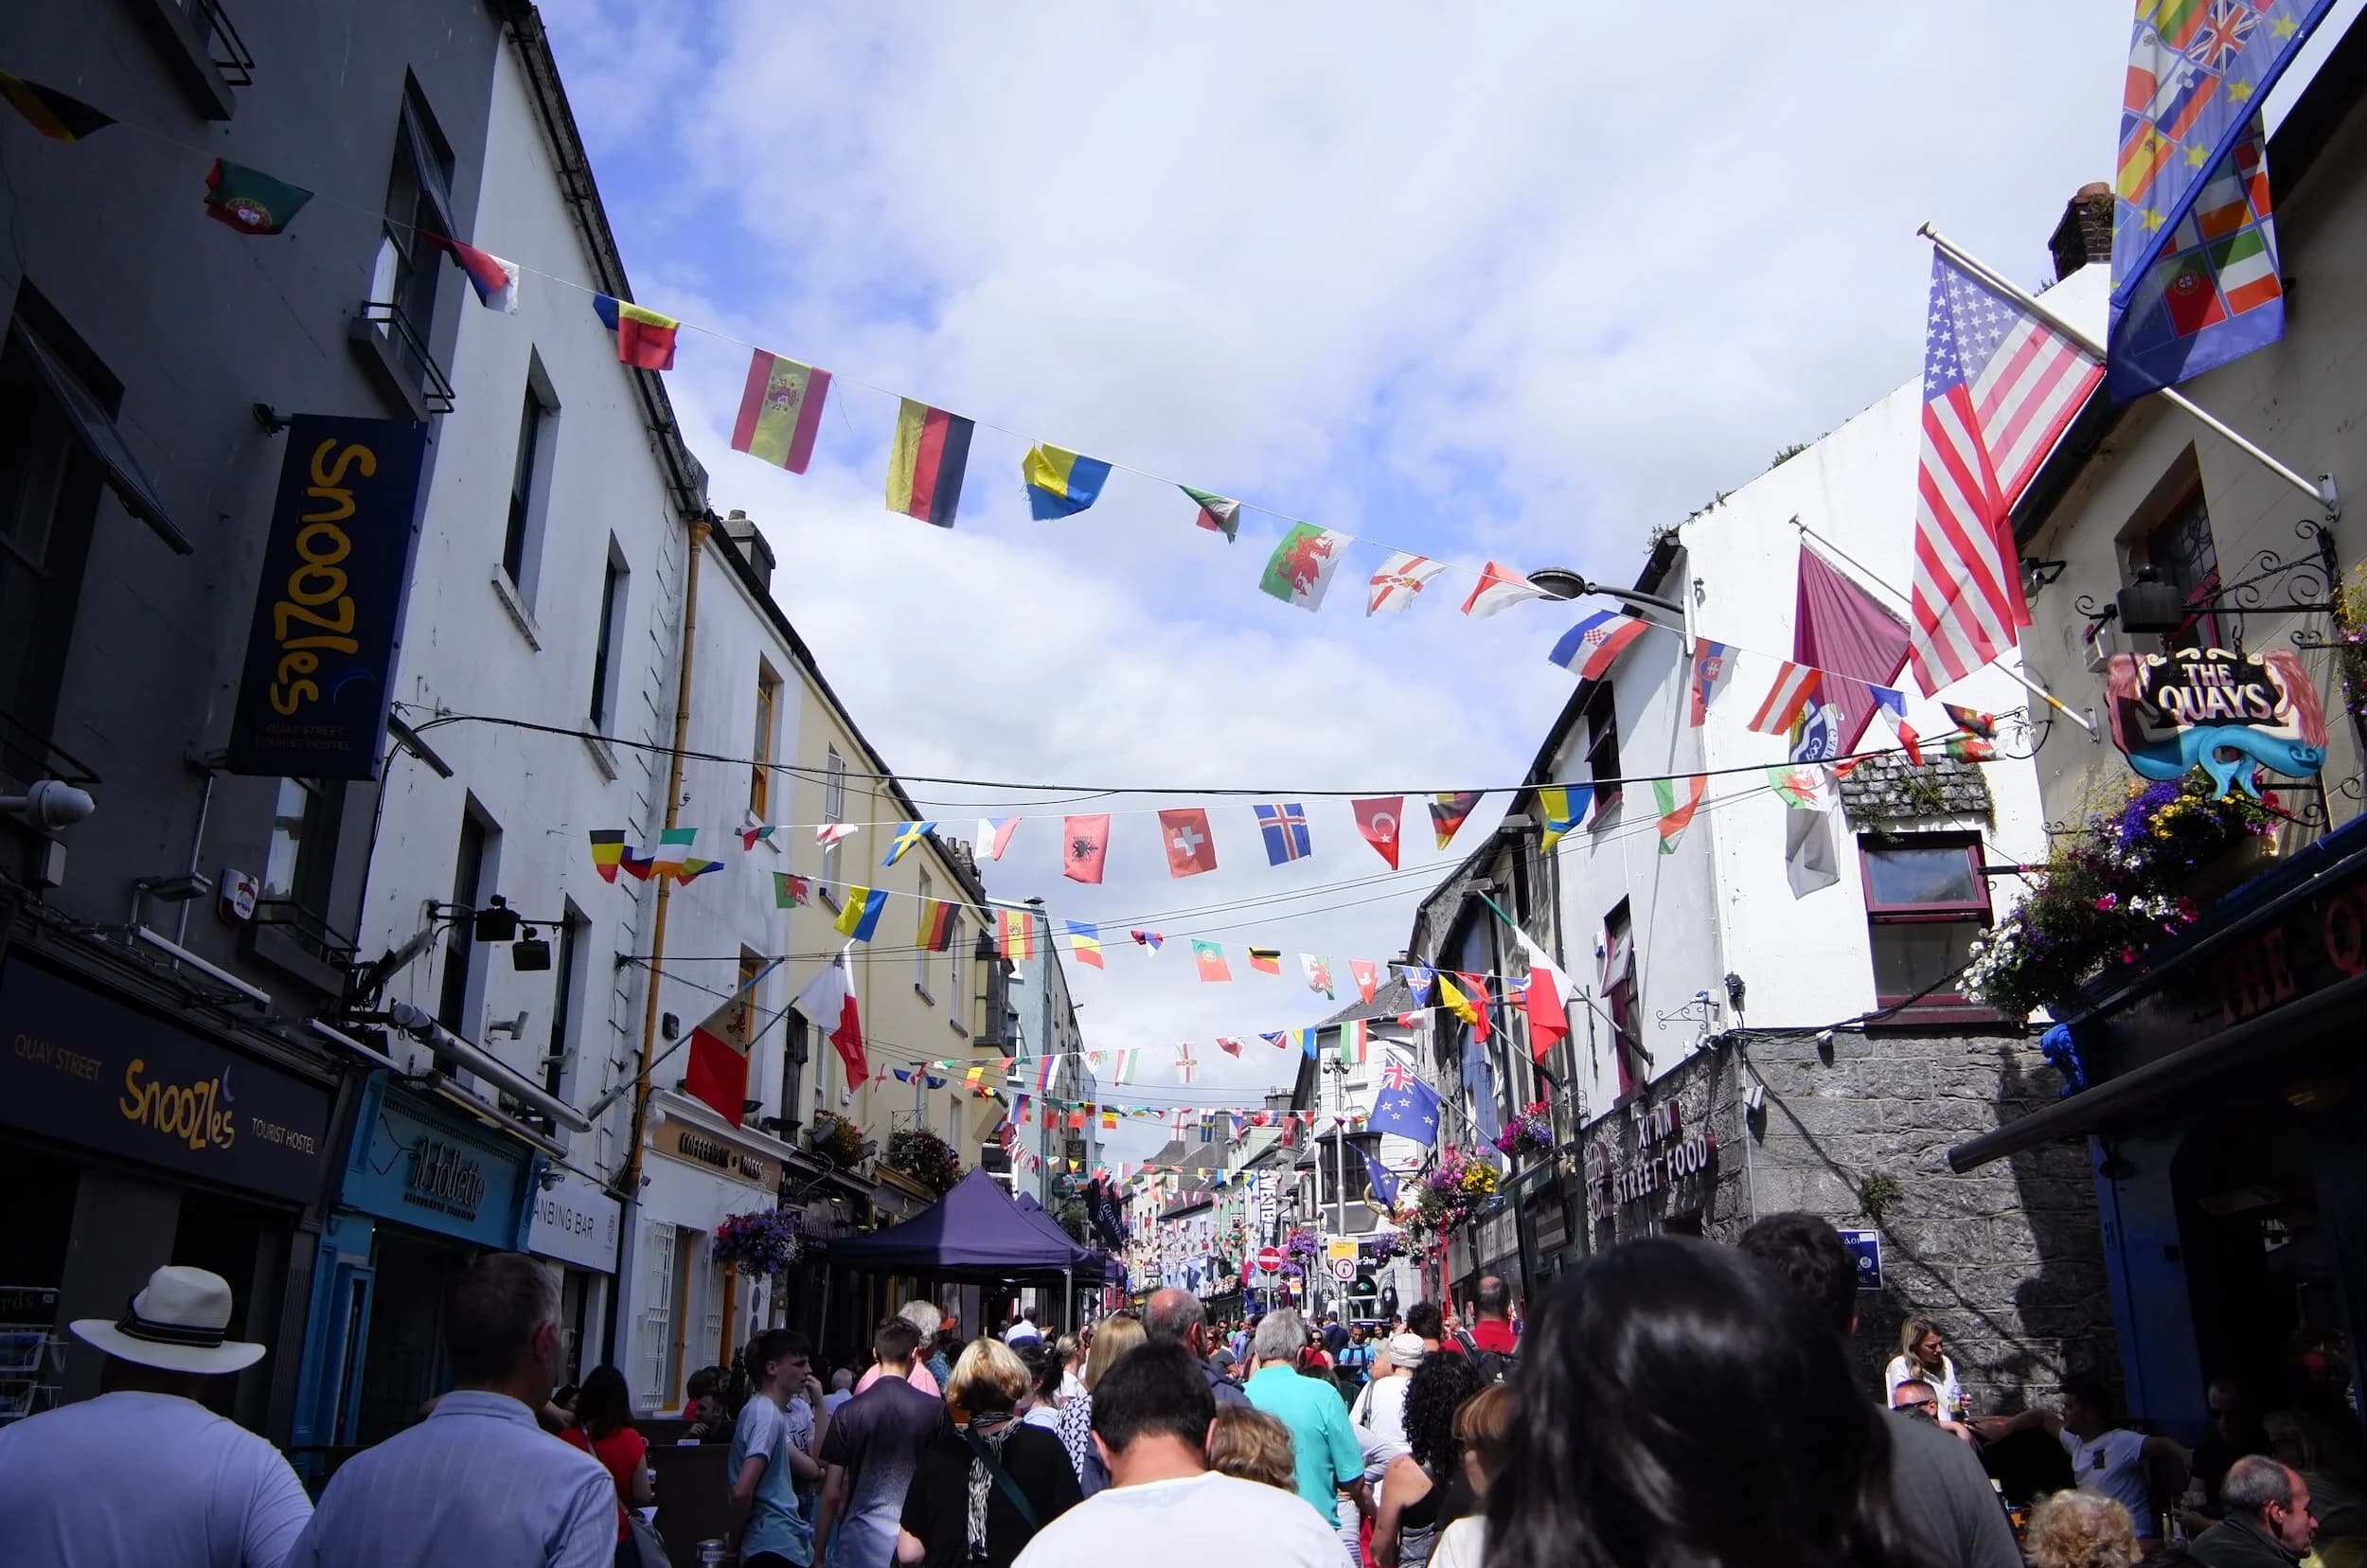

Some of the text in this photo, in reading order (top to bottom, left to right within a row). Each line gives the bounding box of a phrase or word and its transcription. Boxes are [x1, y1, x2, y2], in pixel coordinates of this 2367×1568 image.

[2181, 663, 2234, 687] THE
[2159, 683, 2272, 726] QUAYS
[14, 1033, 102, 1082] QUAY STREET
[251, 1116, 315, 1155] TOURIST HOSTEL
[1612, 1157, 1662, 1205] STREET
[1666, 1133, 1707, 1183] FOOD
[575, 1212, 594, 1239] BAR
